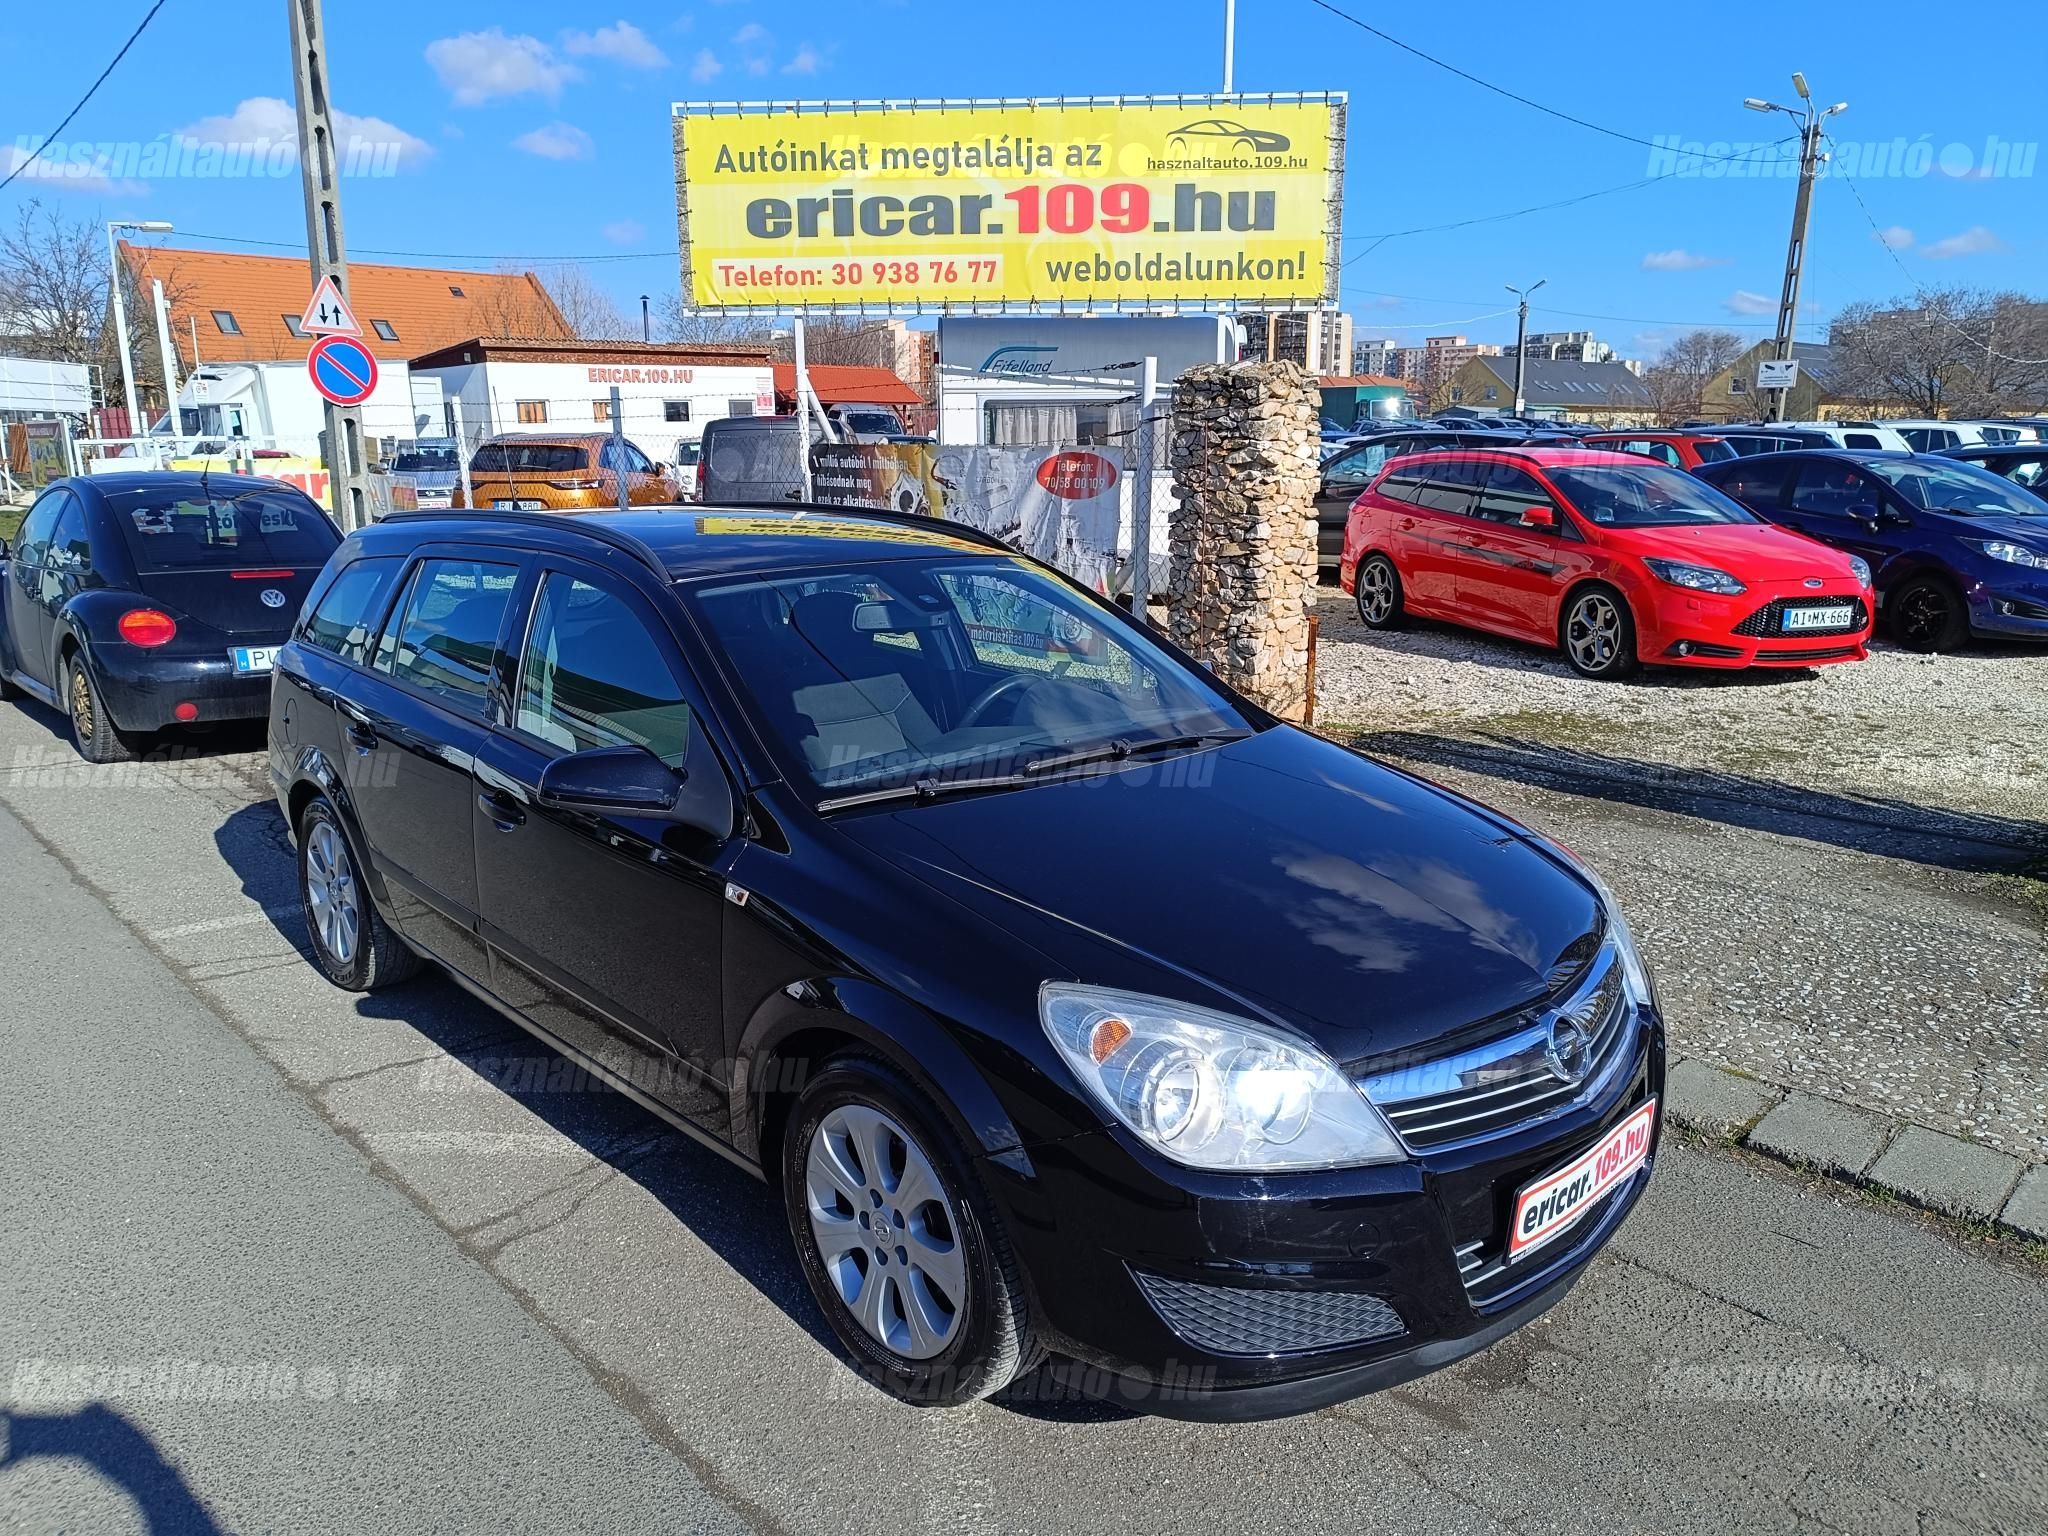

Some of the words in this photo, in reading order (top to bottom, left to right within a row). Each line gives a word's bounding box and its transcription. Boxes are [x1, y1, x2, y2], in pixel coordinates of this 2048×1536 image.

[714, 138, 869, 174] Autóinkat
[881, 134, 1053, 176] megtalálja
[1066, 143, 1102, 167] az
[1147, 156, 1309, 170] hasznaltauto.109.hu
[746, 183, 1276, 239] ericar.109.hu
[719, 264, 823, 288] Telefon:
[831, 262, 863, 286] 30
[872, 261, 920, 285] 938
[929, 260, 958, 283] 76
[967, 260, 998, 283] 77
[1046, 251, 1306, 283] weboldalunkon!
[588, 367, 694, 384] ERICAR.109.HU
[839, 455, 867, 470] autóból
[1057, 460, 1094, 473] Telefon:
[816, 474, 855, 488] hibásodnak
[856, 477, 872, 492] meg
[842, 494, 886, 509] alkatrészek
[1523, 1122, 1646, 1235] ericar.109.hu
